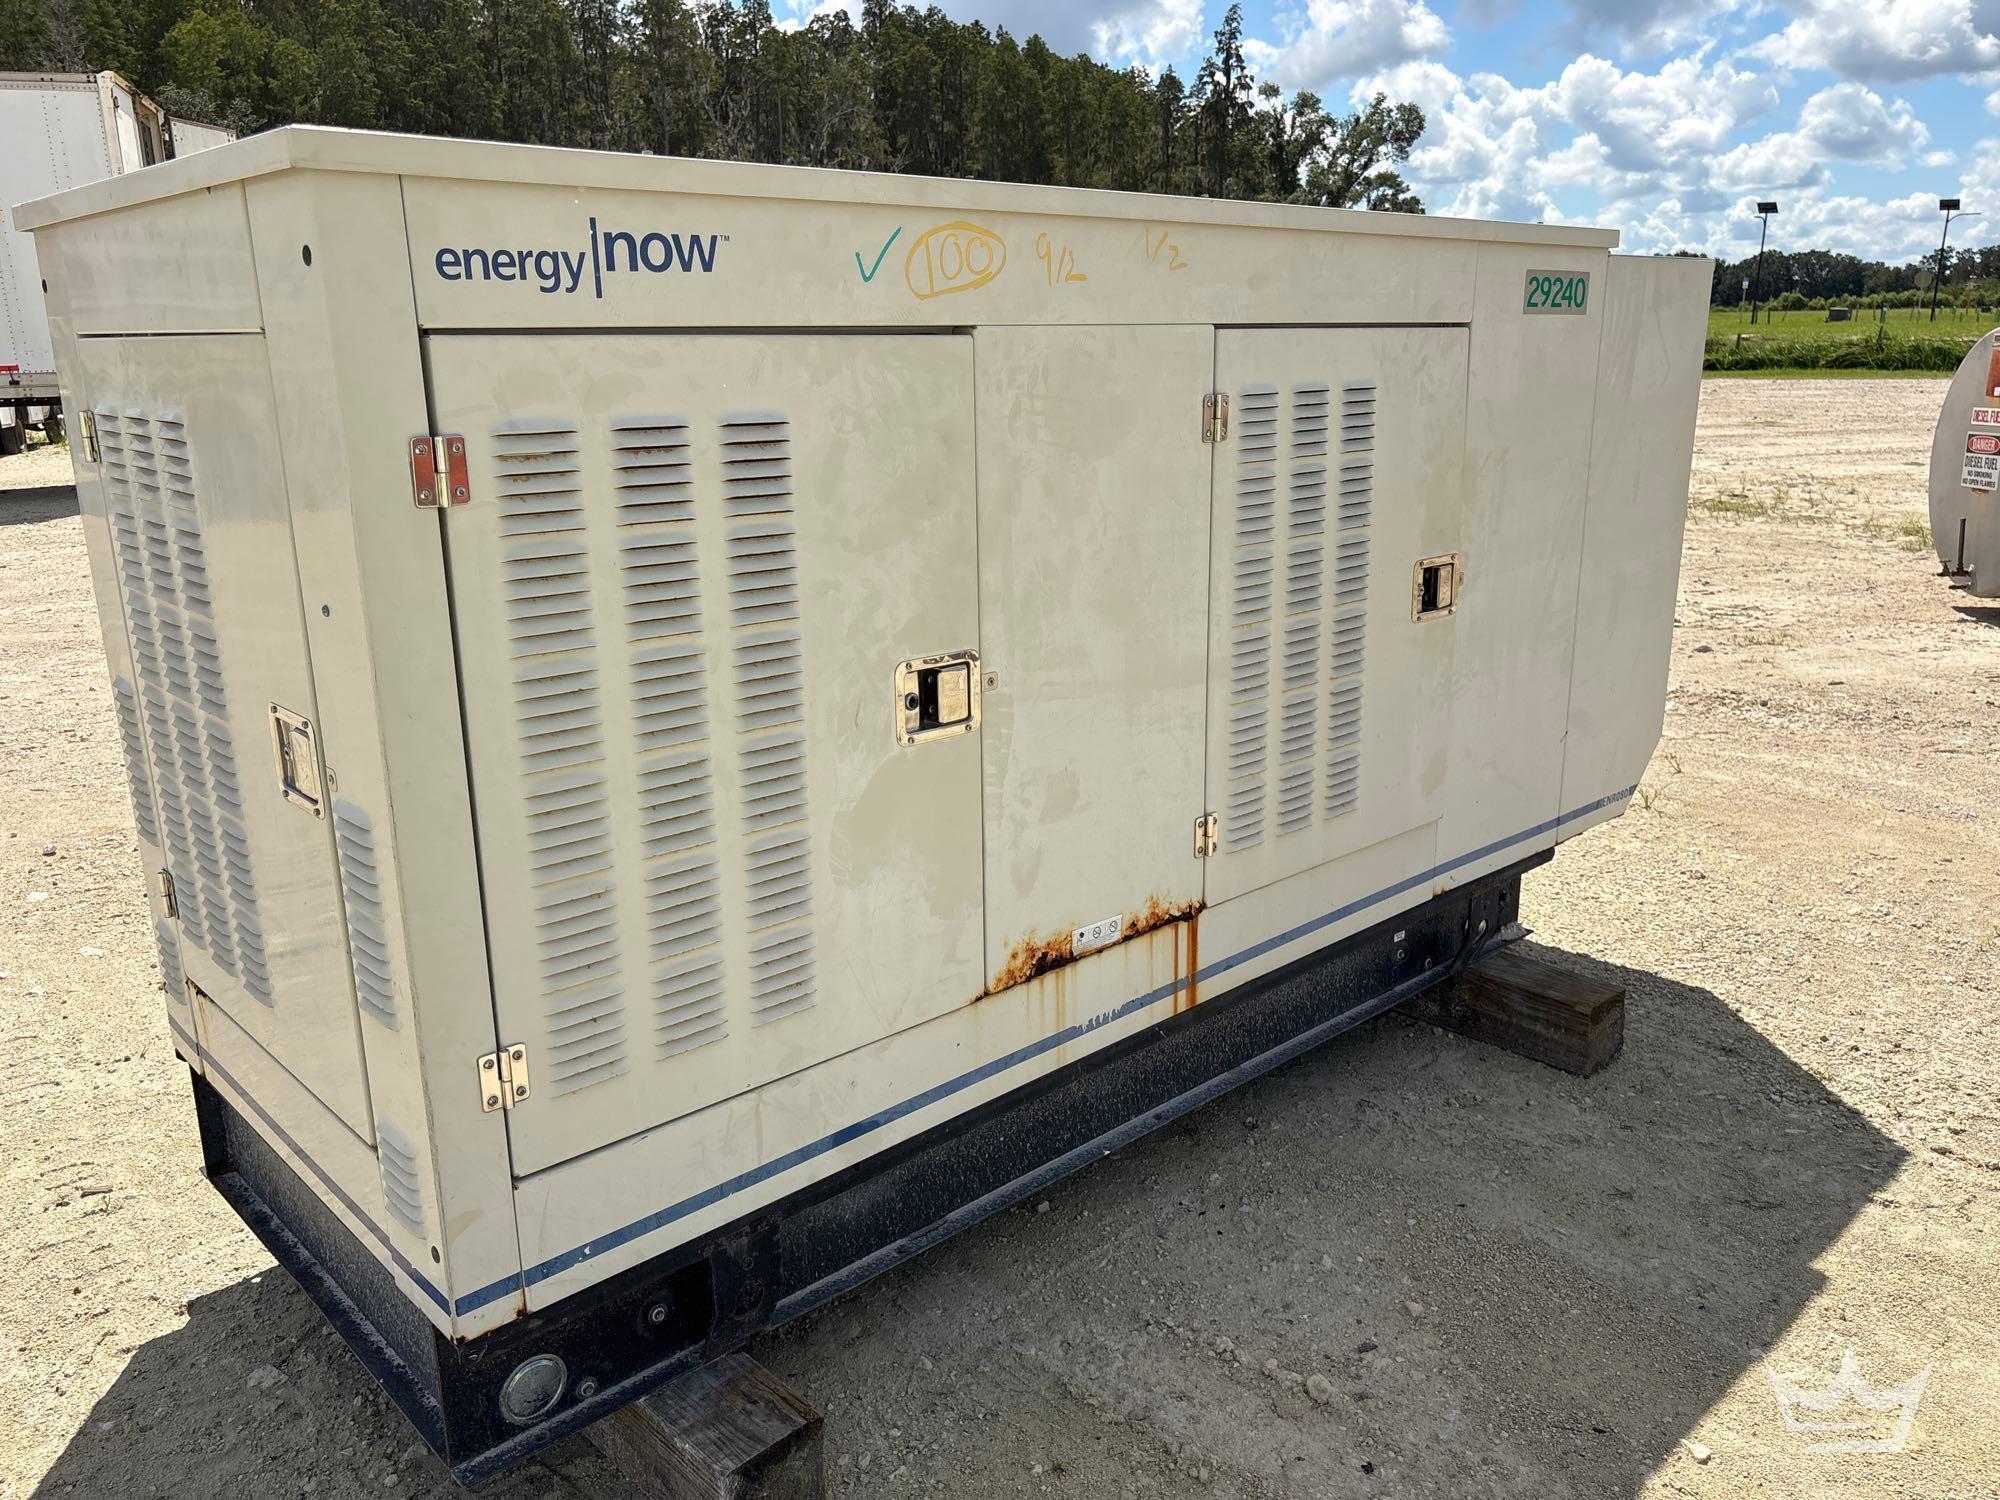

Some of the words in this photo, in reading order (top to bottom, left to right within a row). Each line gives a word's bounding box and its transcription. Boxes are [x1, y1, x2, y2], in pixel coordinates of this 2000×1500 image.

[435, 246, 586, 294] energy
[603, 230, 718, 273] now
[1526, 276, 1587, 308] 29240
[1973, 409, 1989, 423] DIESEL
[1990, 410, 2000, 424] FUE
[1972, 438, 1996, 451] DANGER
[1964, 455, 1983, 469] DIESEL
[1983, 457, 1998, 471] FUEL
[1974, 470, 1993, 480] SMOKING
